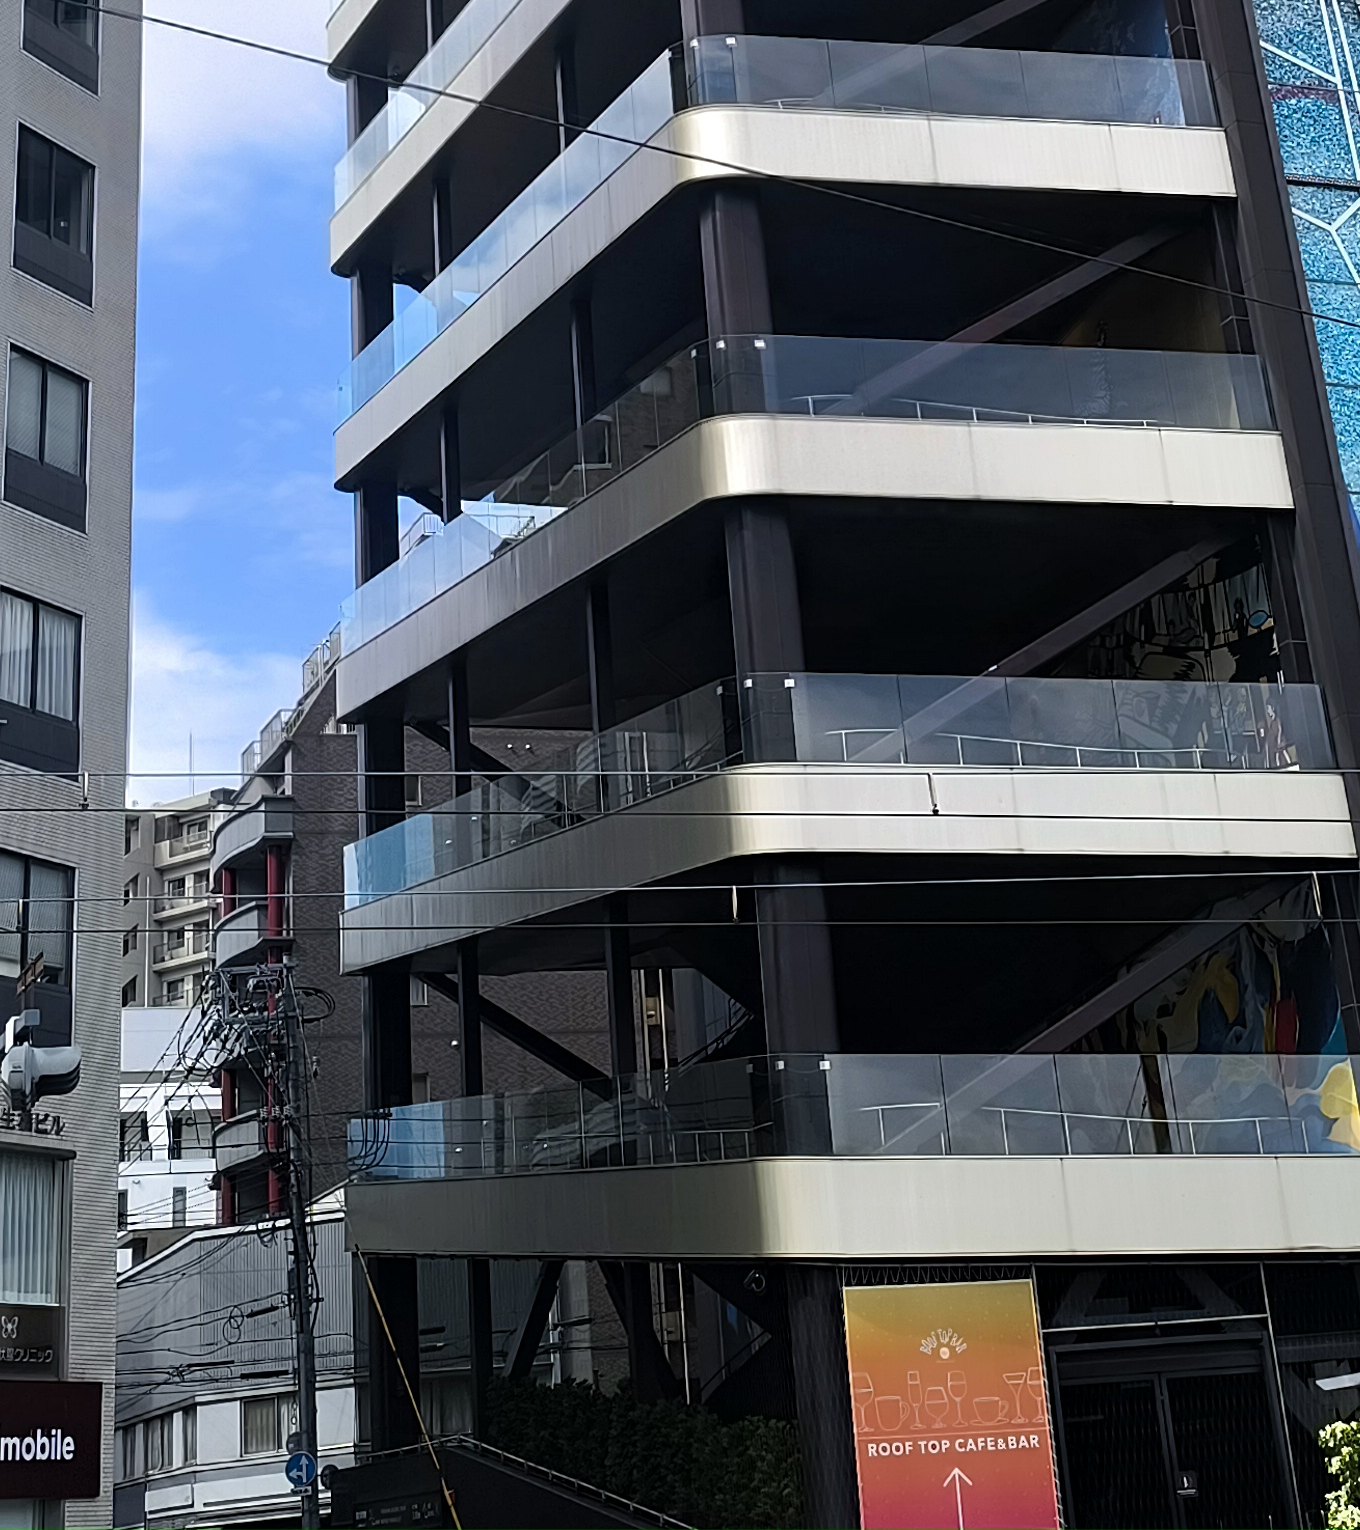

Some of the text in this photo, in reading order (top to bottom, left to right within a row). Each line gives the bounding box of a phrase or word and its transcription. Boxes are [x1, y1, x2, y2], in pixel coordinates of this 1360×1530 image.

[868, 1434, 1041, 1458] ROOF TOP CAFE&BAR
